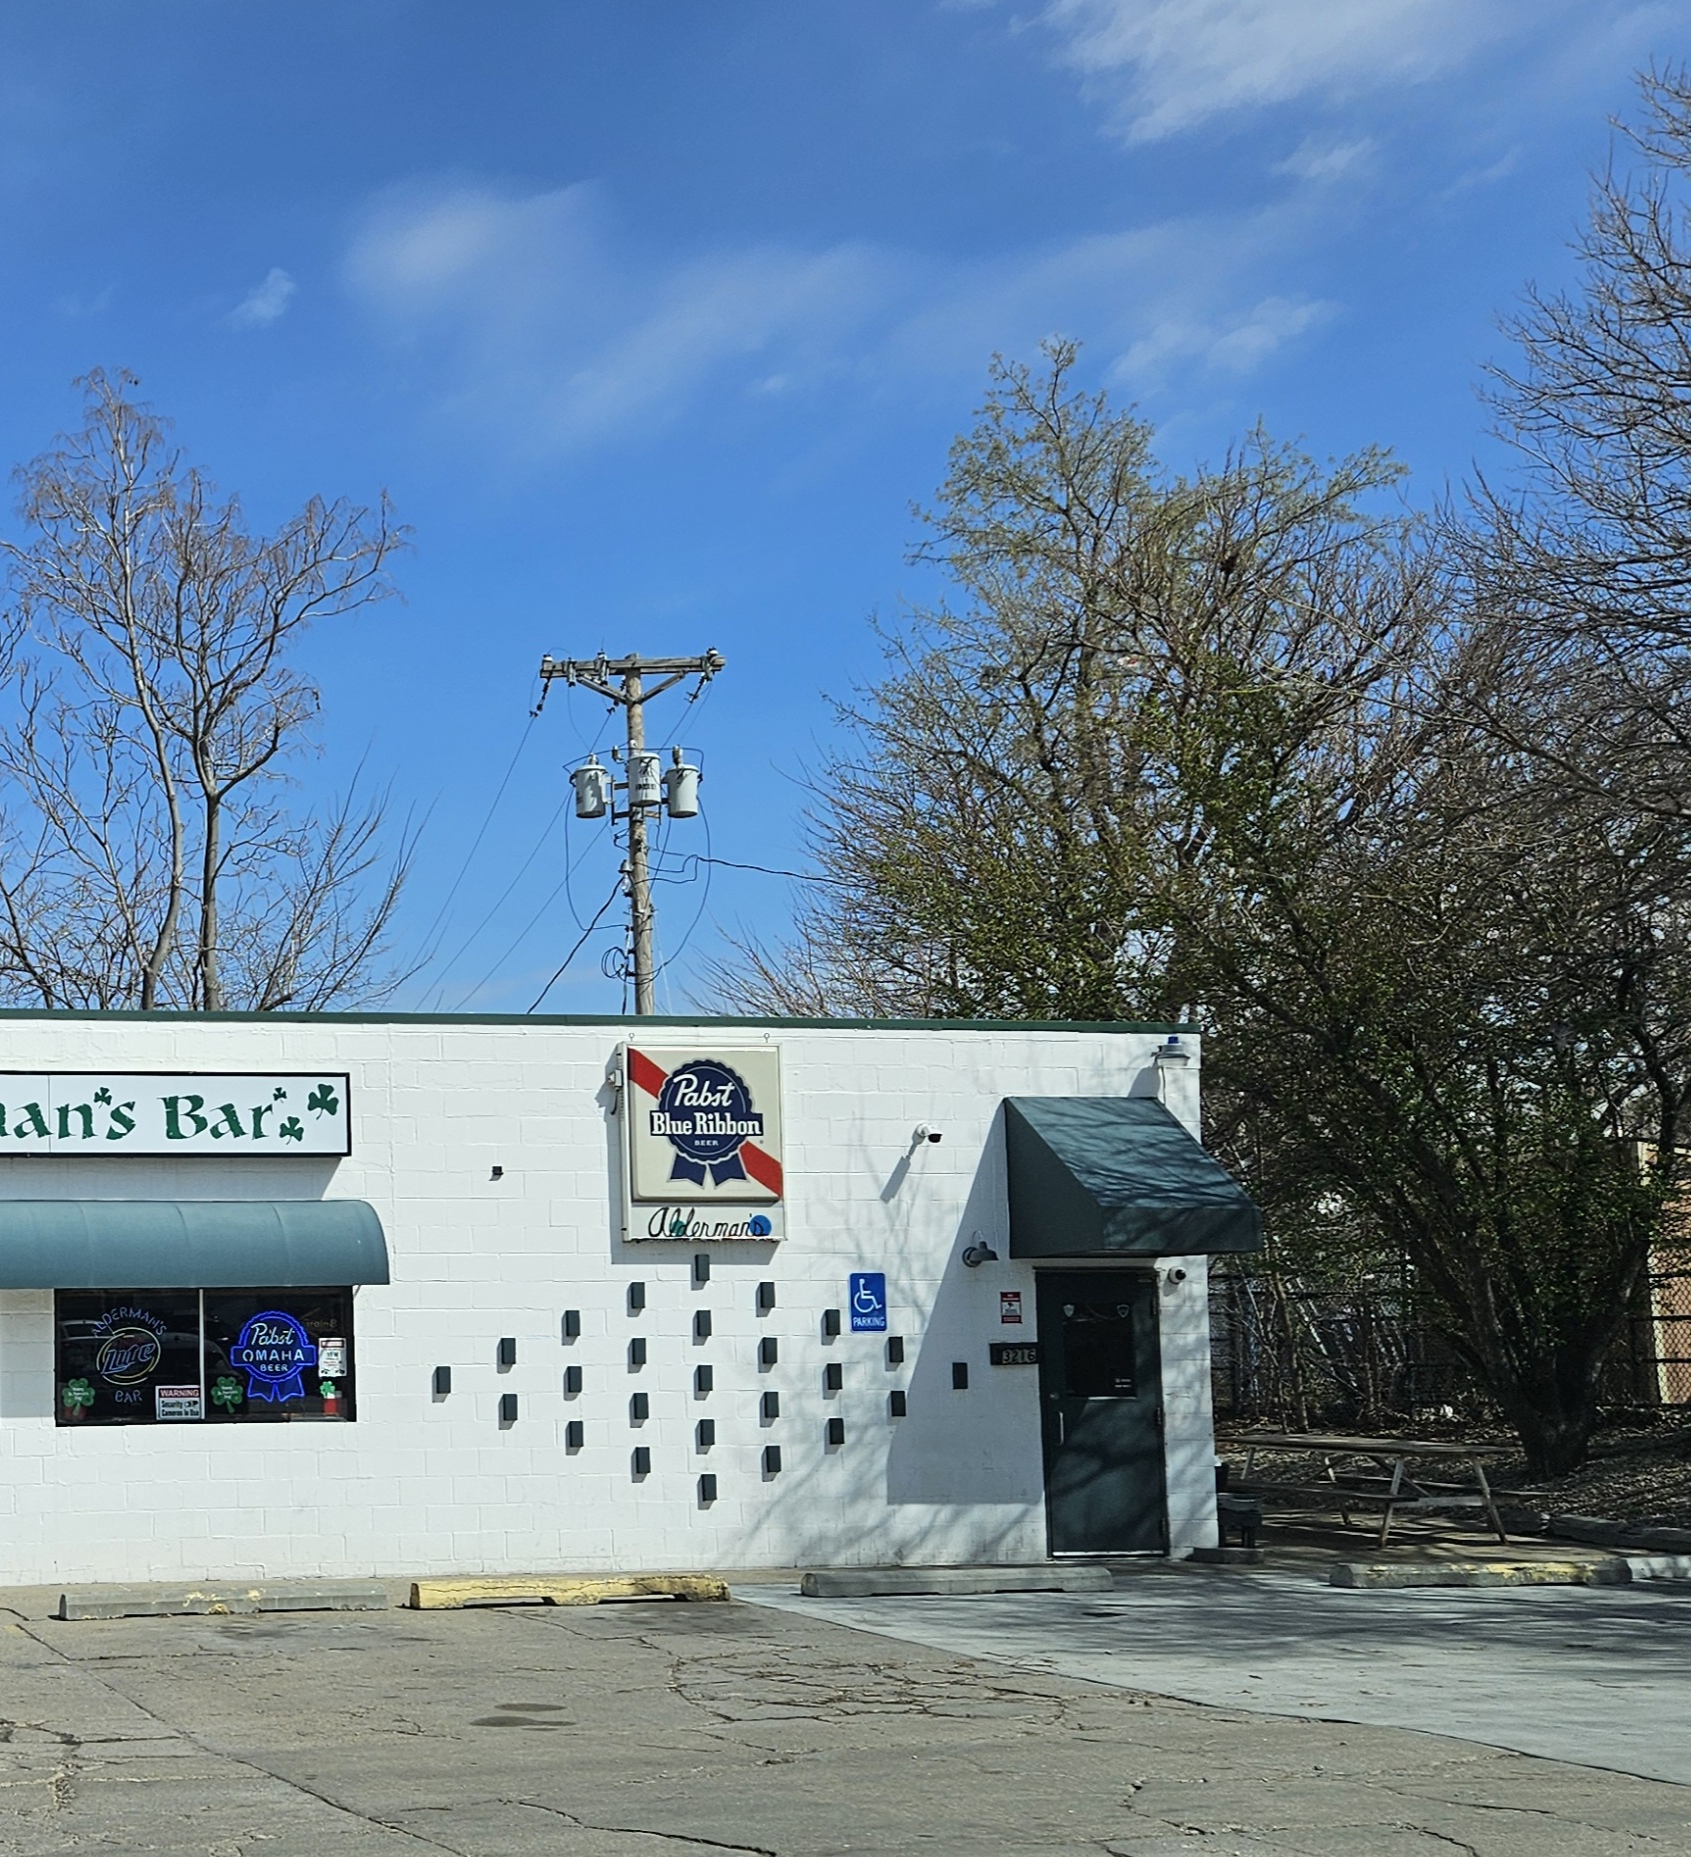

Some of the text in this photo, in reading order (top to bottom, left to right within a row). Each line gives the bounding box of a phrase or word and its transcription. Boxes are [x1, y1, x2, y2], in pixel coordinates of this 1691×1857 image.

[673, 1073, 735, 1107] Pabst
[157, 1094, 273, 1140] Bar
[651, 1111, 762, 1135] Blue Ribbon
[853, 1317, 885, 1327] PARKING
[251, 1322, 294, 1346] Pabst
[242, 1349, 305, 1362] OMAHA
[1003, 1350, 1035, 1363] 3216
[260, 1363, 289, 1372] BEER
[115, 1390, 142, 1403] BAR
[160, 1389, 199, 1397] WARNING
